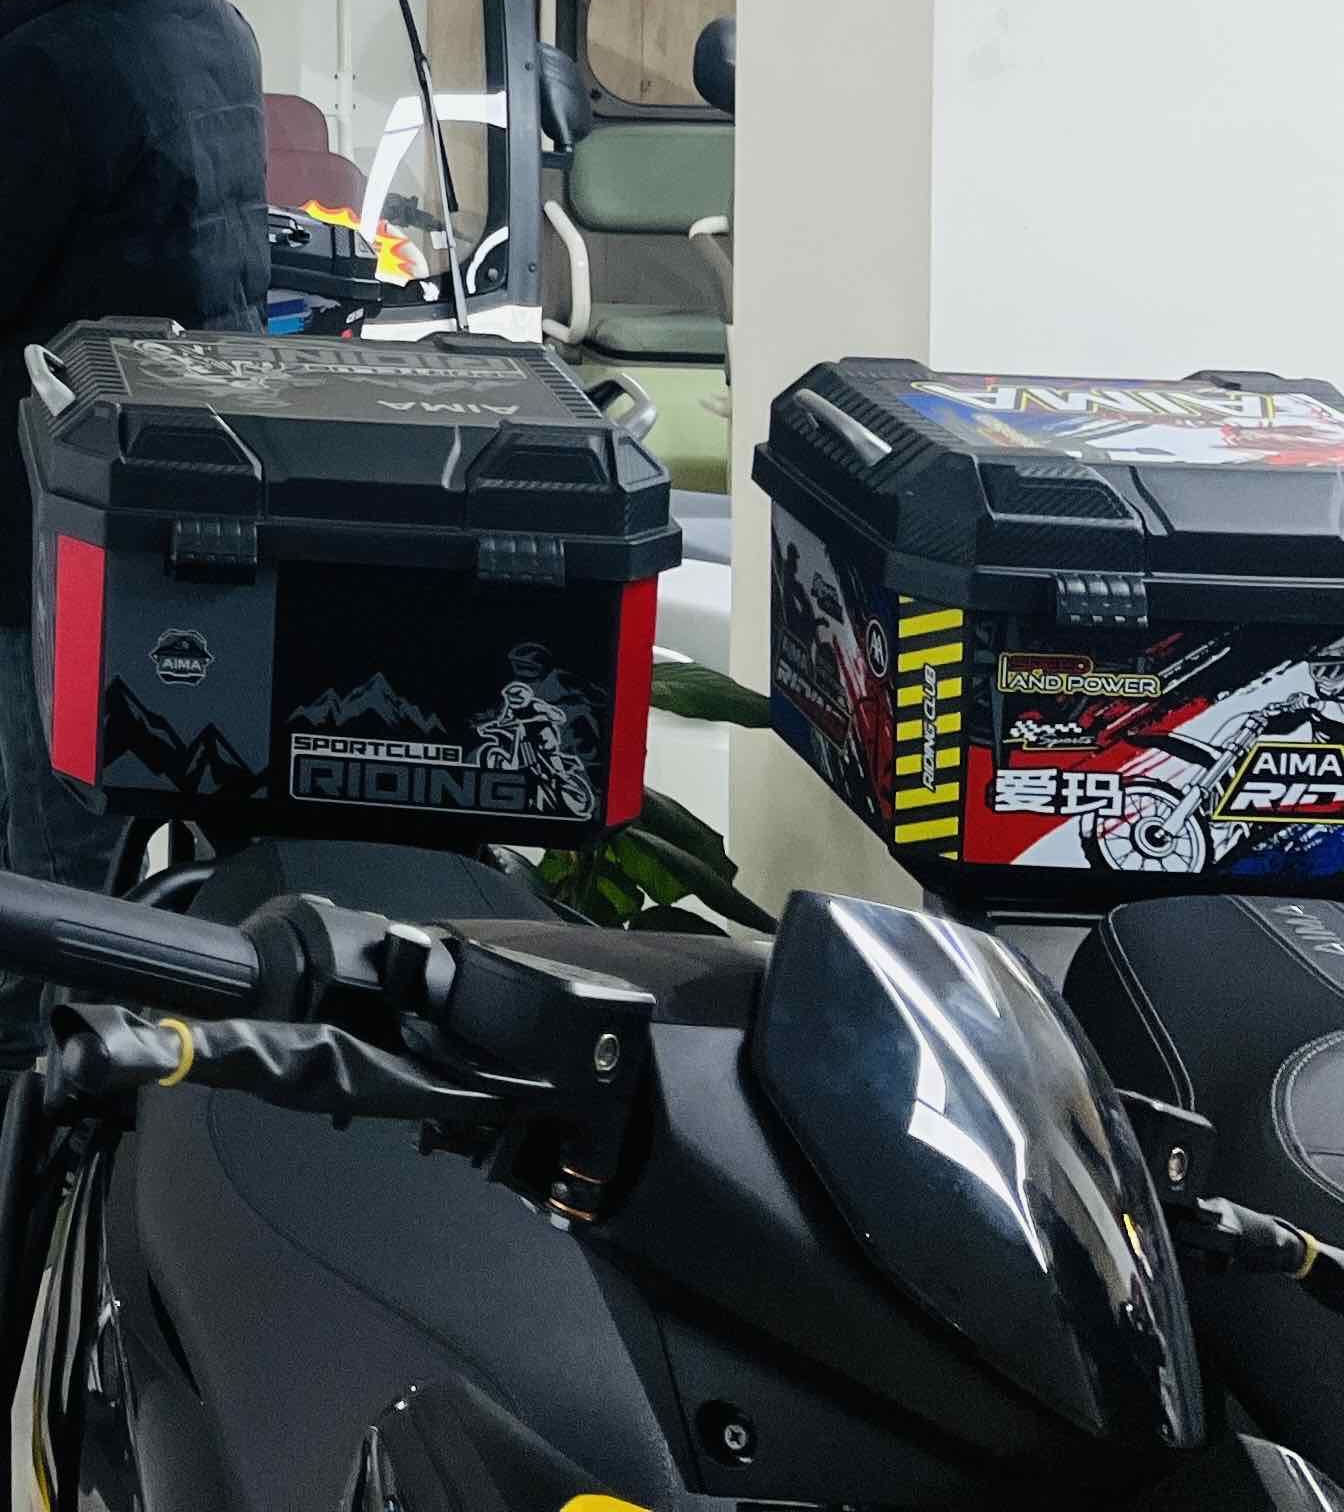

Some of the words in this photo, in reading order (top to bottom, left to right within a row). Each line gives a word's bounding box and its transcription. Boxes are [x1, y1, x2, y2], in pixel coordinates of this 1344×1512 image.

[376, 399, 520, 415] AIMA
[162, 658, 202, 671] AIMA
[924, 664, 936, 720] CLUB
[1067, 675, 1157, 694] POWER
[294, 736, 460, 762] SPORTCLUB
[923, 720, 936, 792] RIDING
[1252, 752, 1343, 777] AIMA
[298, 757, 528, 810] RIDING
[995, 768, 1123, 817] 爱玛
